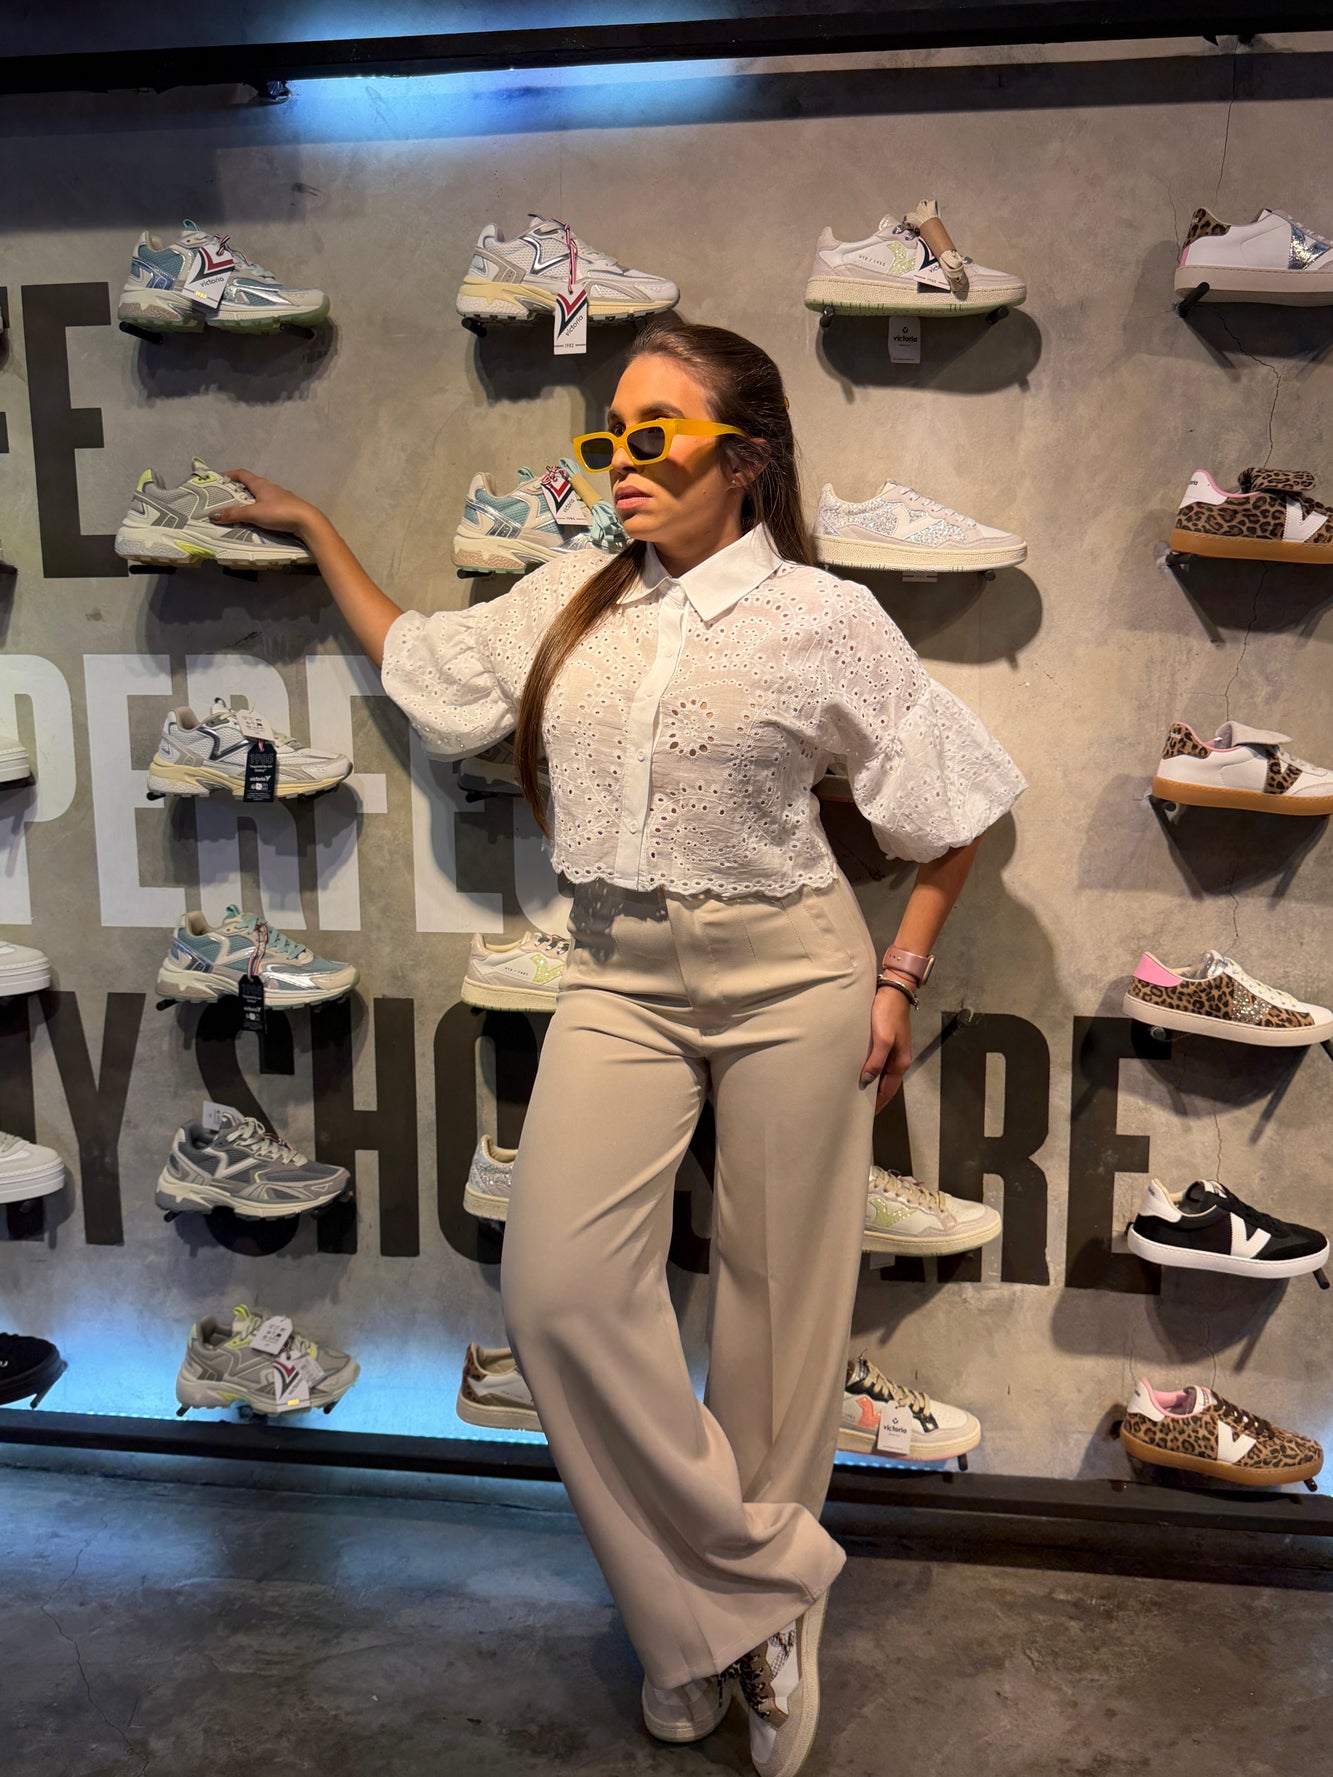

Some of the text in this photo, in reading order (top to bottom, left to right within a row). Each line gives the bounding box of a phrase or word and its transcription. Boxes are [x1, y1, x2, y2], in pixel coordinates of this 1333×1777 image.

[200, 276, 225, 288] victoria
[565, 315, 584, 337] victoria
[893, 335, 918, 343] victoria
[0, 282, 129, 578] E
[883, 1424, 908, 1434] victoria
